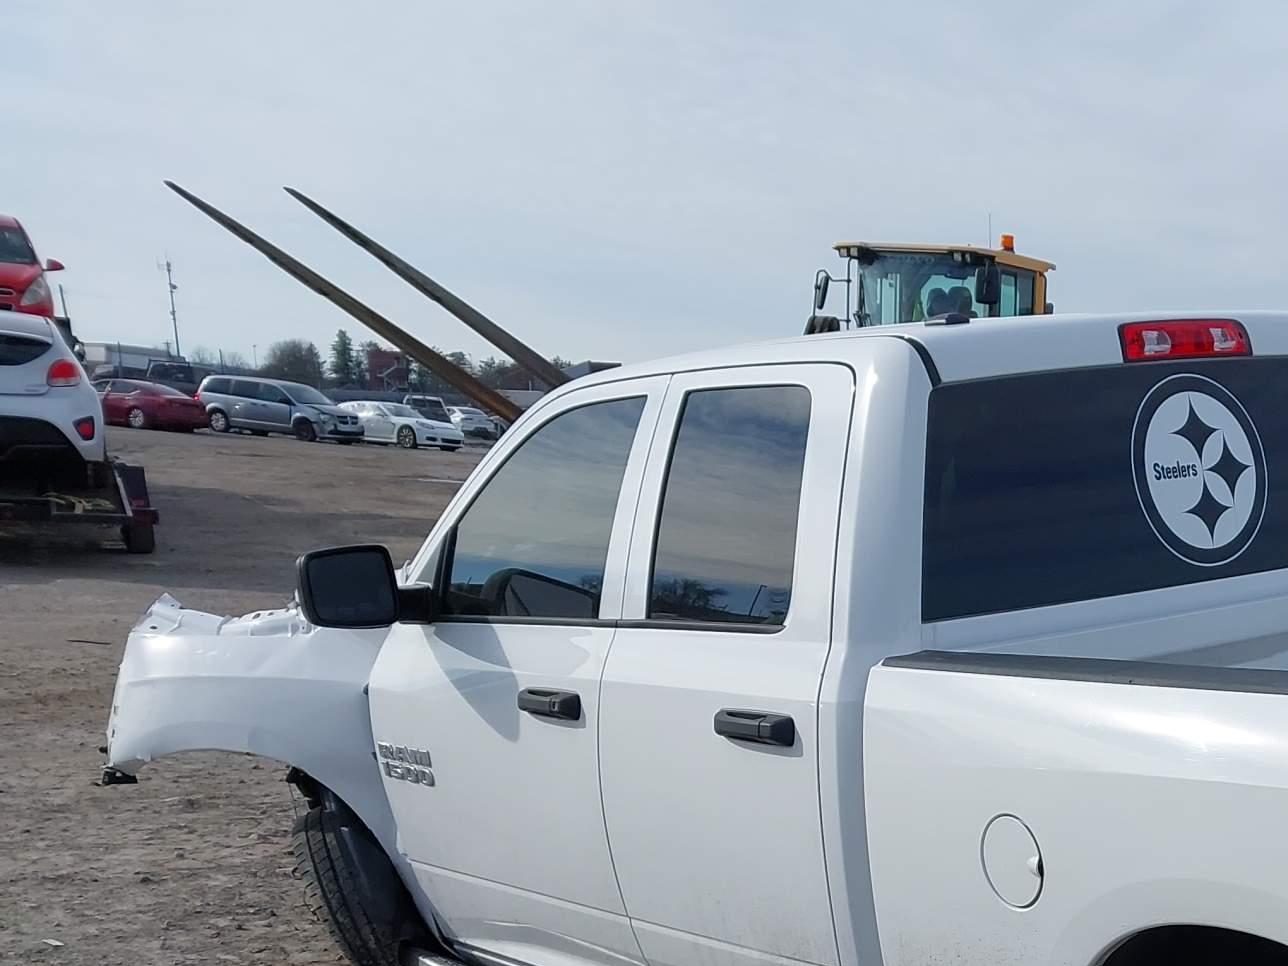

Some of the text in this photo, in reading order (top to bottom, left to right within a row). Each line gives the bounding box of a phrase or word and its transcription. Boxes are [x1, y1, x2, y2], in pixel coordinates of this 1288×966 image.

[1153, 460, 1198, 481] Steelers
[377, 741, 433, 768] RAM
[380, 760, 436, 787] 1500
